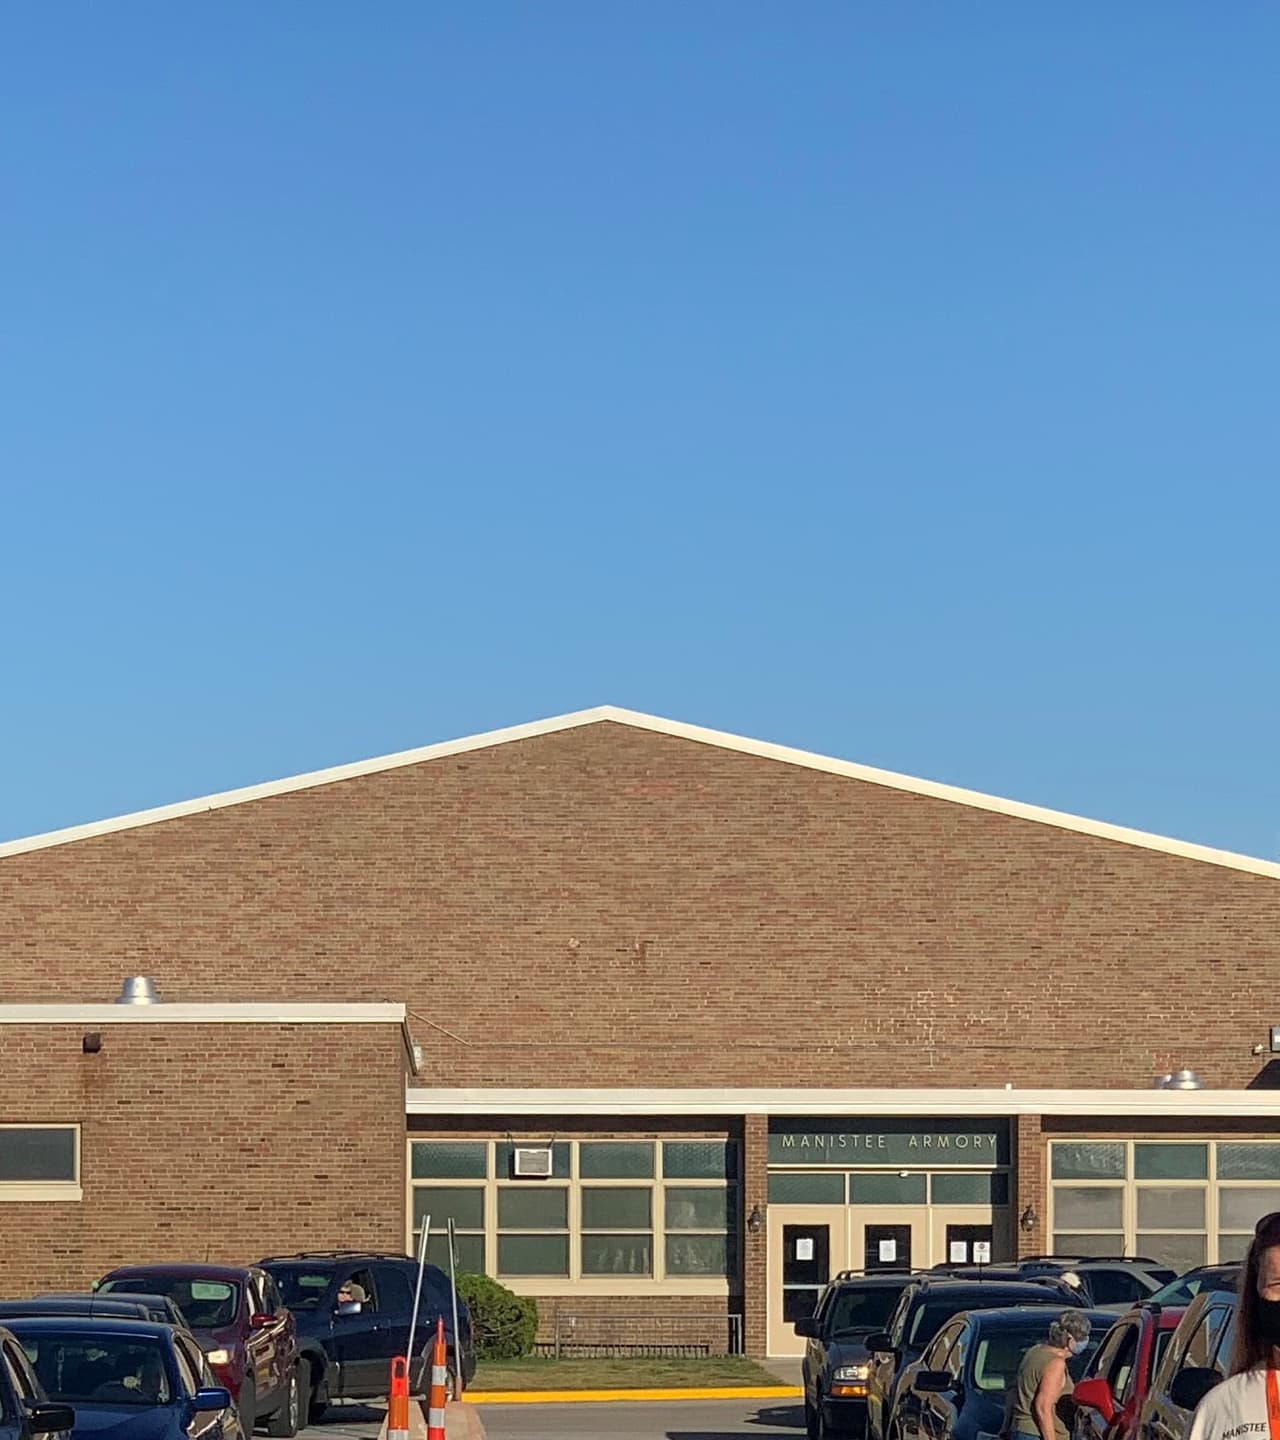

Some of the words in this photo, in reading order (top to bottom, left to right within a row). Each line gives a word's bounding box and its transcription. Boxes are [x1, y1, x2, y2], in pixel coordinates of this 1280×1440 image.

[782, 1135, 886, 1149] MANISTEE
[908, 1135, 997, 1148] ARMORY
[1222, 1423, 1267, 1440] MANISTEE
